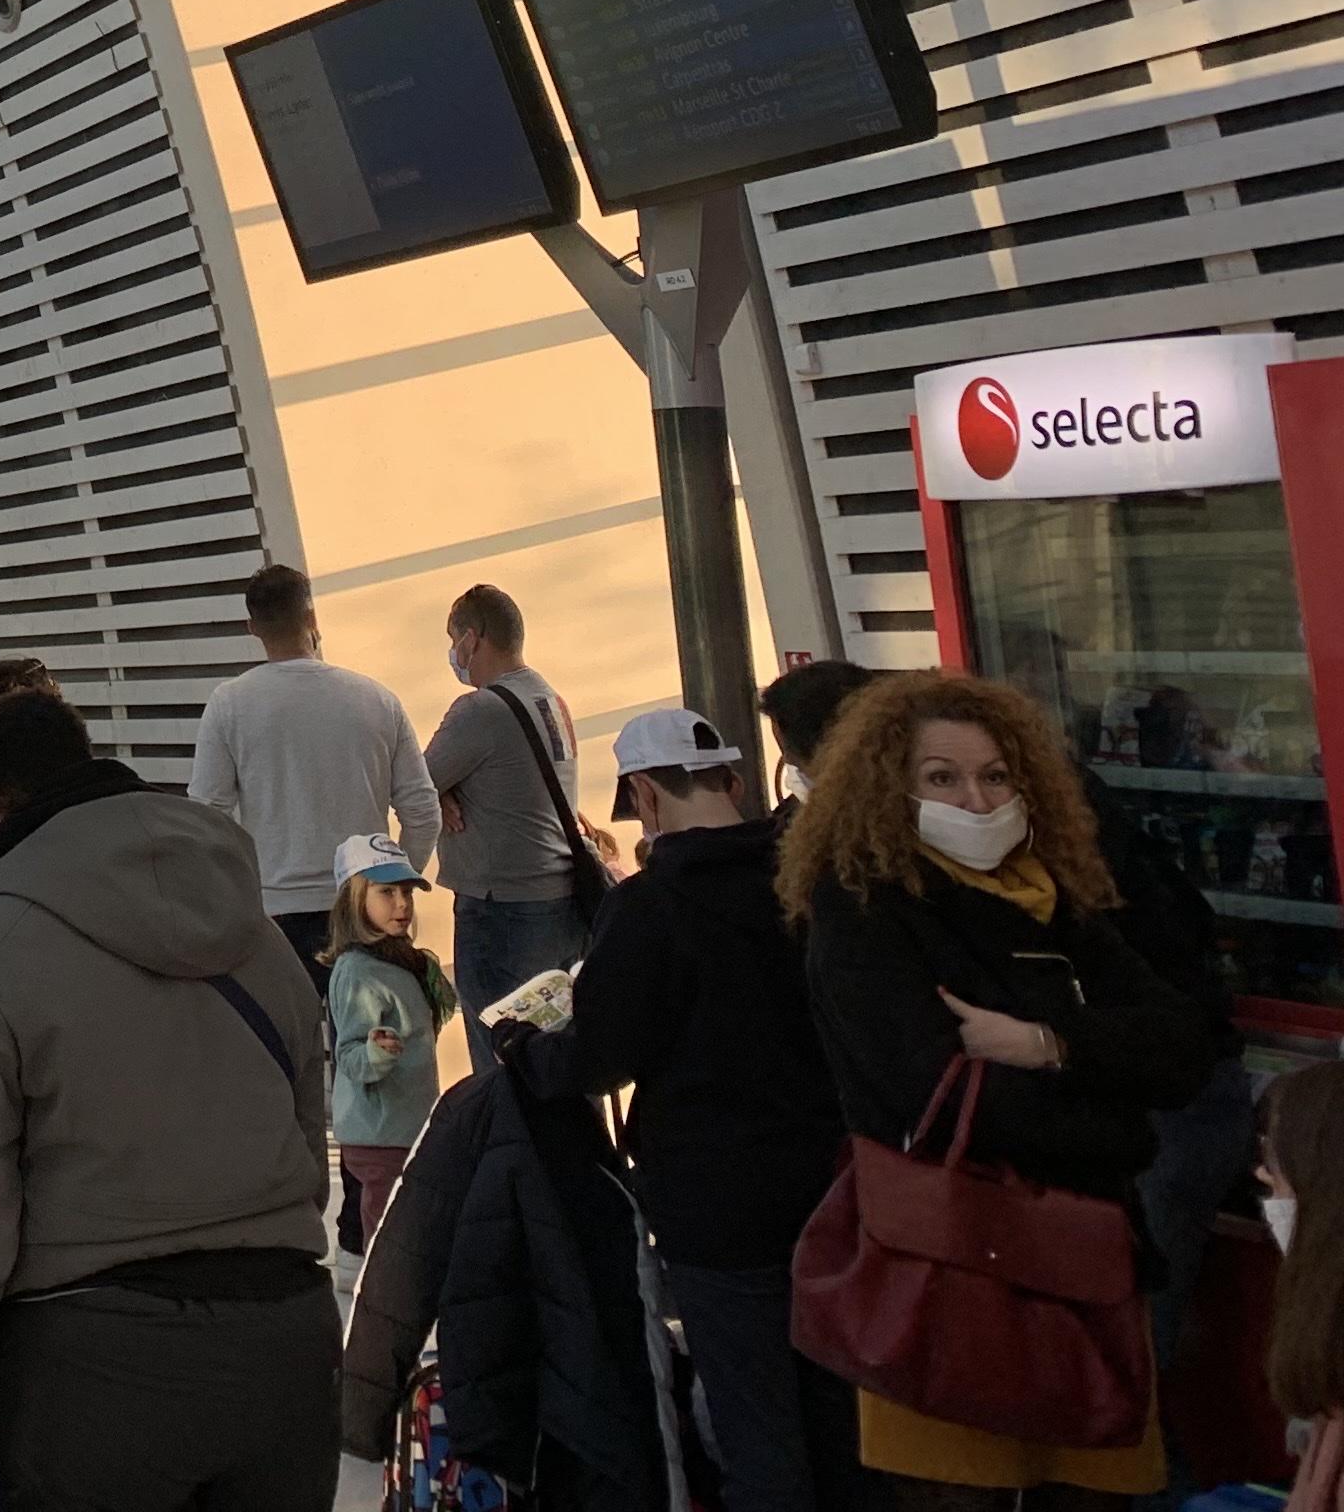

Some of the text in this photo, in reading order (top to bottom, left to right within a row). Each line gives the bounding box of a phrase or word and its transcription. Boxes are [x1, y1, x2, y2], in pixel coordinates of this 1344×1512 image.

[652, 37, 703, 65] Avignon
[703, 22, 750, 49] Centre
[661, 58, 733, 91] Carpentras
[672, 88, 731, 117] Marseille
[731, 80, 747, 102] St
[1031, 391, 1202, 449] selecta
